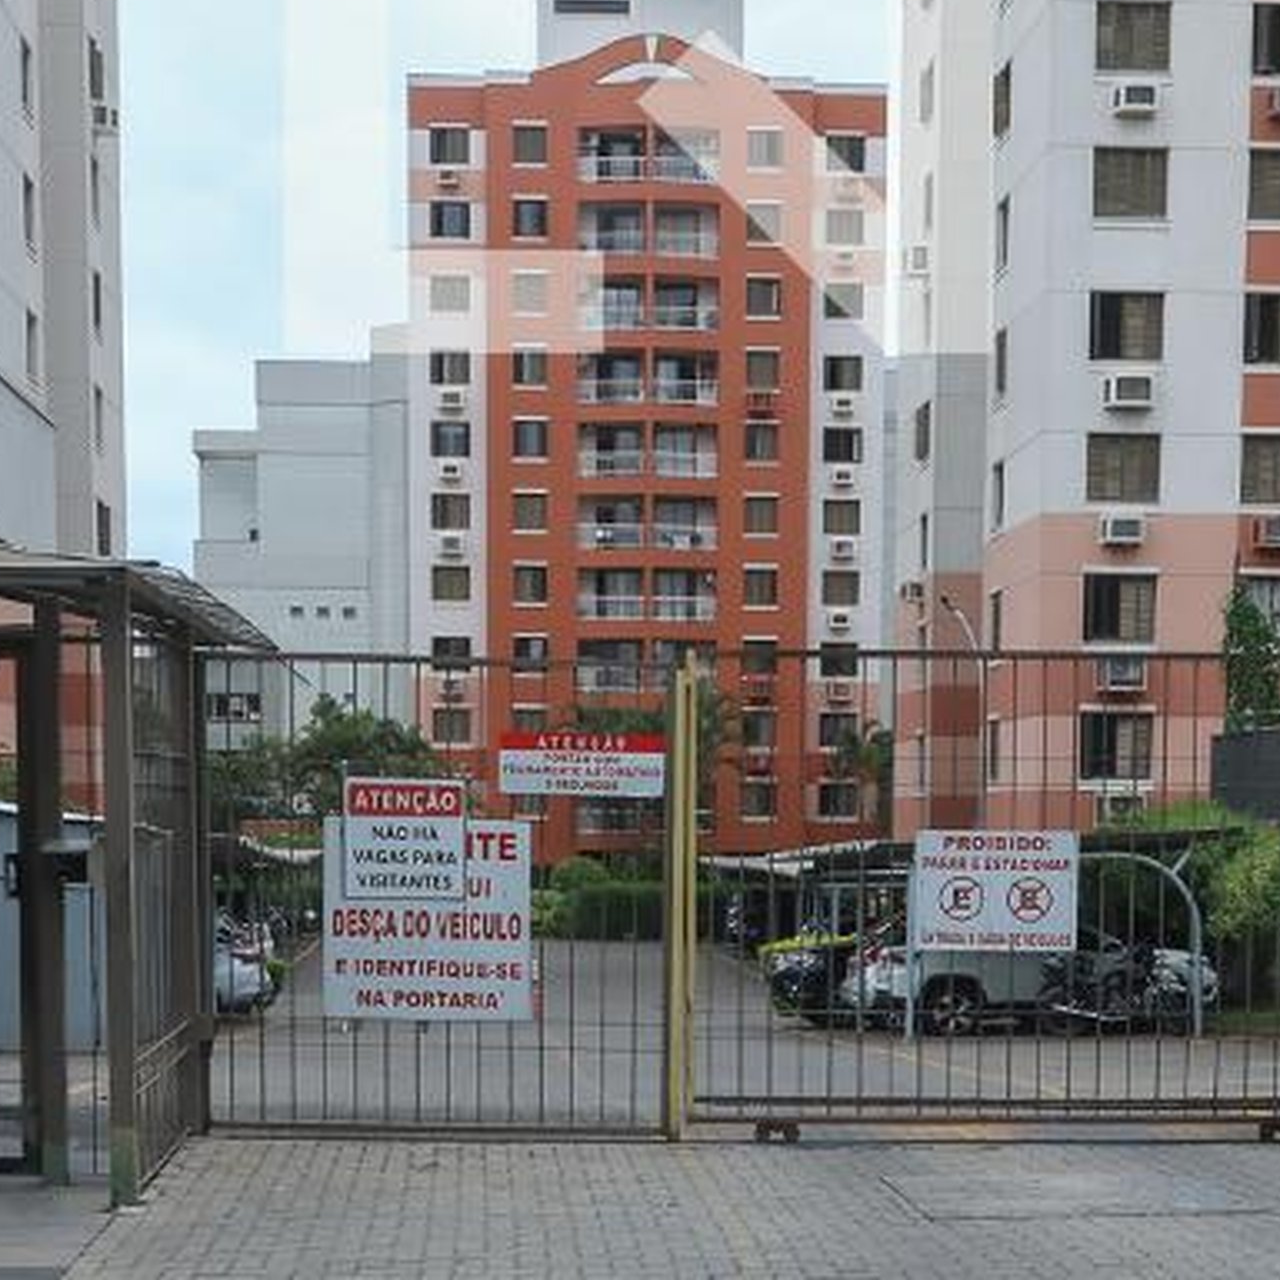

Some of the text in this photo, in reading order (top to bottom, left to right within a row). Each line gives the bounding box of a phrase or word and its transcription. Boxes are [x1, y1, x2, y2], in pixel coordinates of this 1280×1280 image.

[352, 849, 458, 865] VAGAS PARA
[355, 872, 453, 891] VISITANTES
[332, 906, 522, 943] DESÇA DO VEÍCULO
[335, 958, 523, 981] E IDENTIFIQUE-SE
[357, 989, 385, 1007] NA
